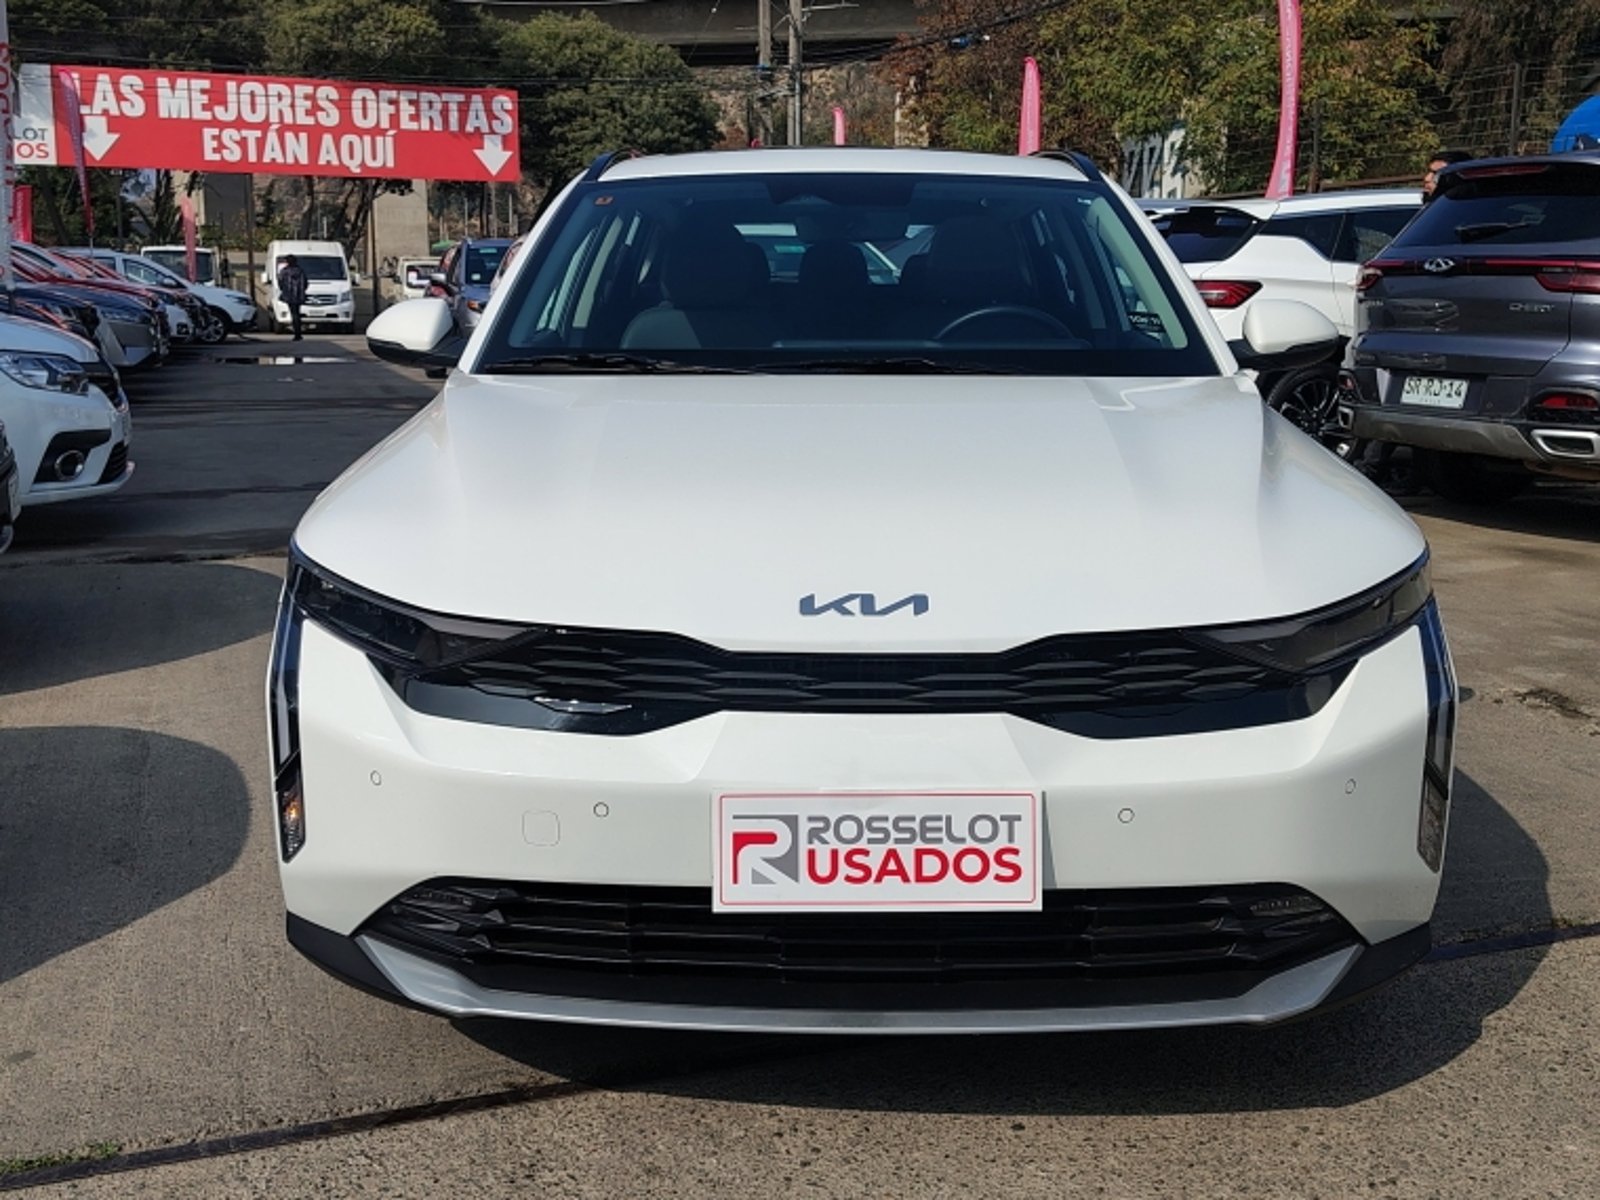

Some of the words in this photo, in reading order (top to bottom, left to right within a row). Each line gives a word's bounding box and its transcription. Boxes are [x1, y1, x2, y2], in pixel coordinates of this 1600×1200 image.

[72, 73, 146, 117] LAS
[156, 77, 340, 126] MEJORES
[351, 88, 513, 135] OFERTAS
[203, 124, 309, 165] ESTÁN
[318, 130, 397, 173] AQUÍ
[799, 593, 929, 617] KIA
[806, 814, 1022, 845] ROSSELOT
[807, 847, 1022, 884] USADOS
